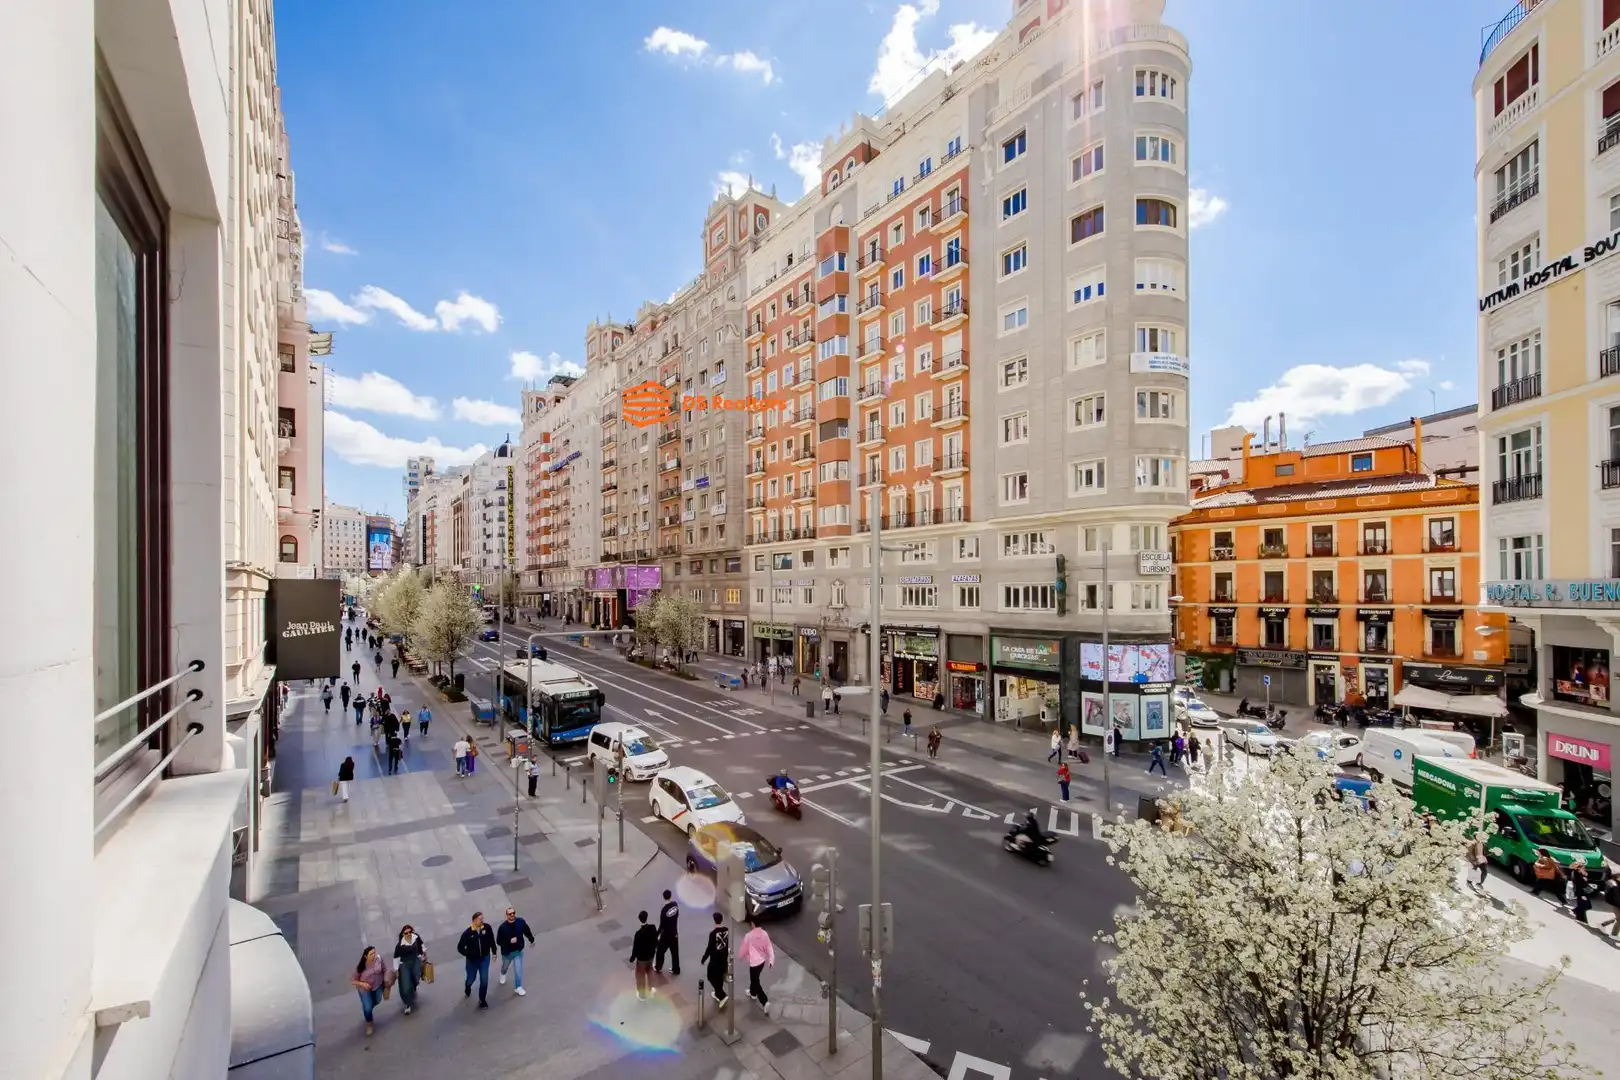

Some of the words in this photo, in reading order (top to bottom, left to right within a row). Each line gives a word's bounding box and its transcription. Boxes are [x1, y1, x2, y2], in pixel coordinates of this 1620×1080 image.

[1479, 283, 1520, 311] VITIUM
[1523, 256, 1579, 290] HOSTAL
[1584, 231, 1620, 262] BOU
[1486, 583, 1539, 601] HOSTAL
[282, 624, 335, 638] GAULTIER
[286, 620, 308, 630] Jean
[309, 620, 330, 630] Paul
[1555, 740, 1600, 761] DRUNI
[1417, 769, 1457, 791] MERCADONA
